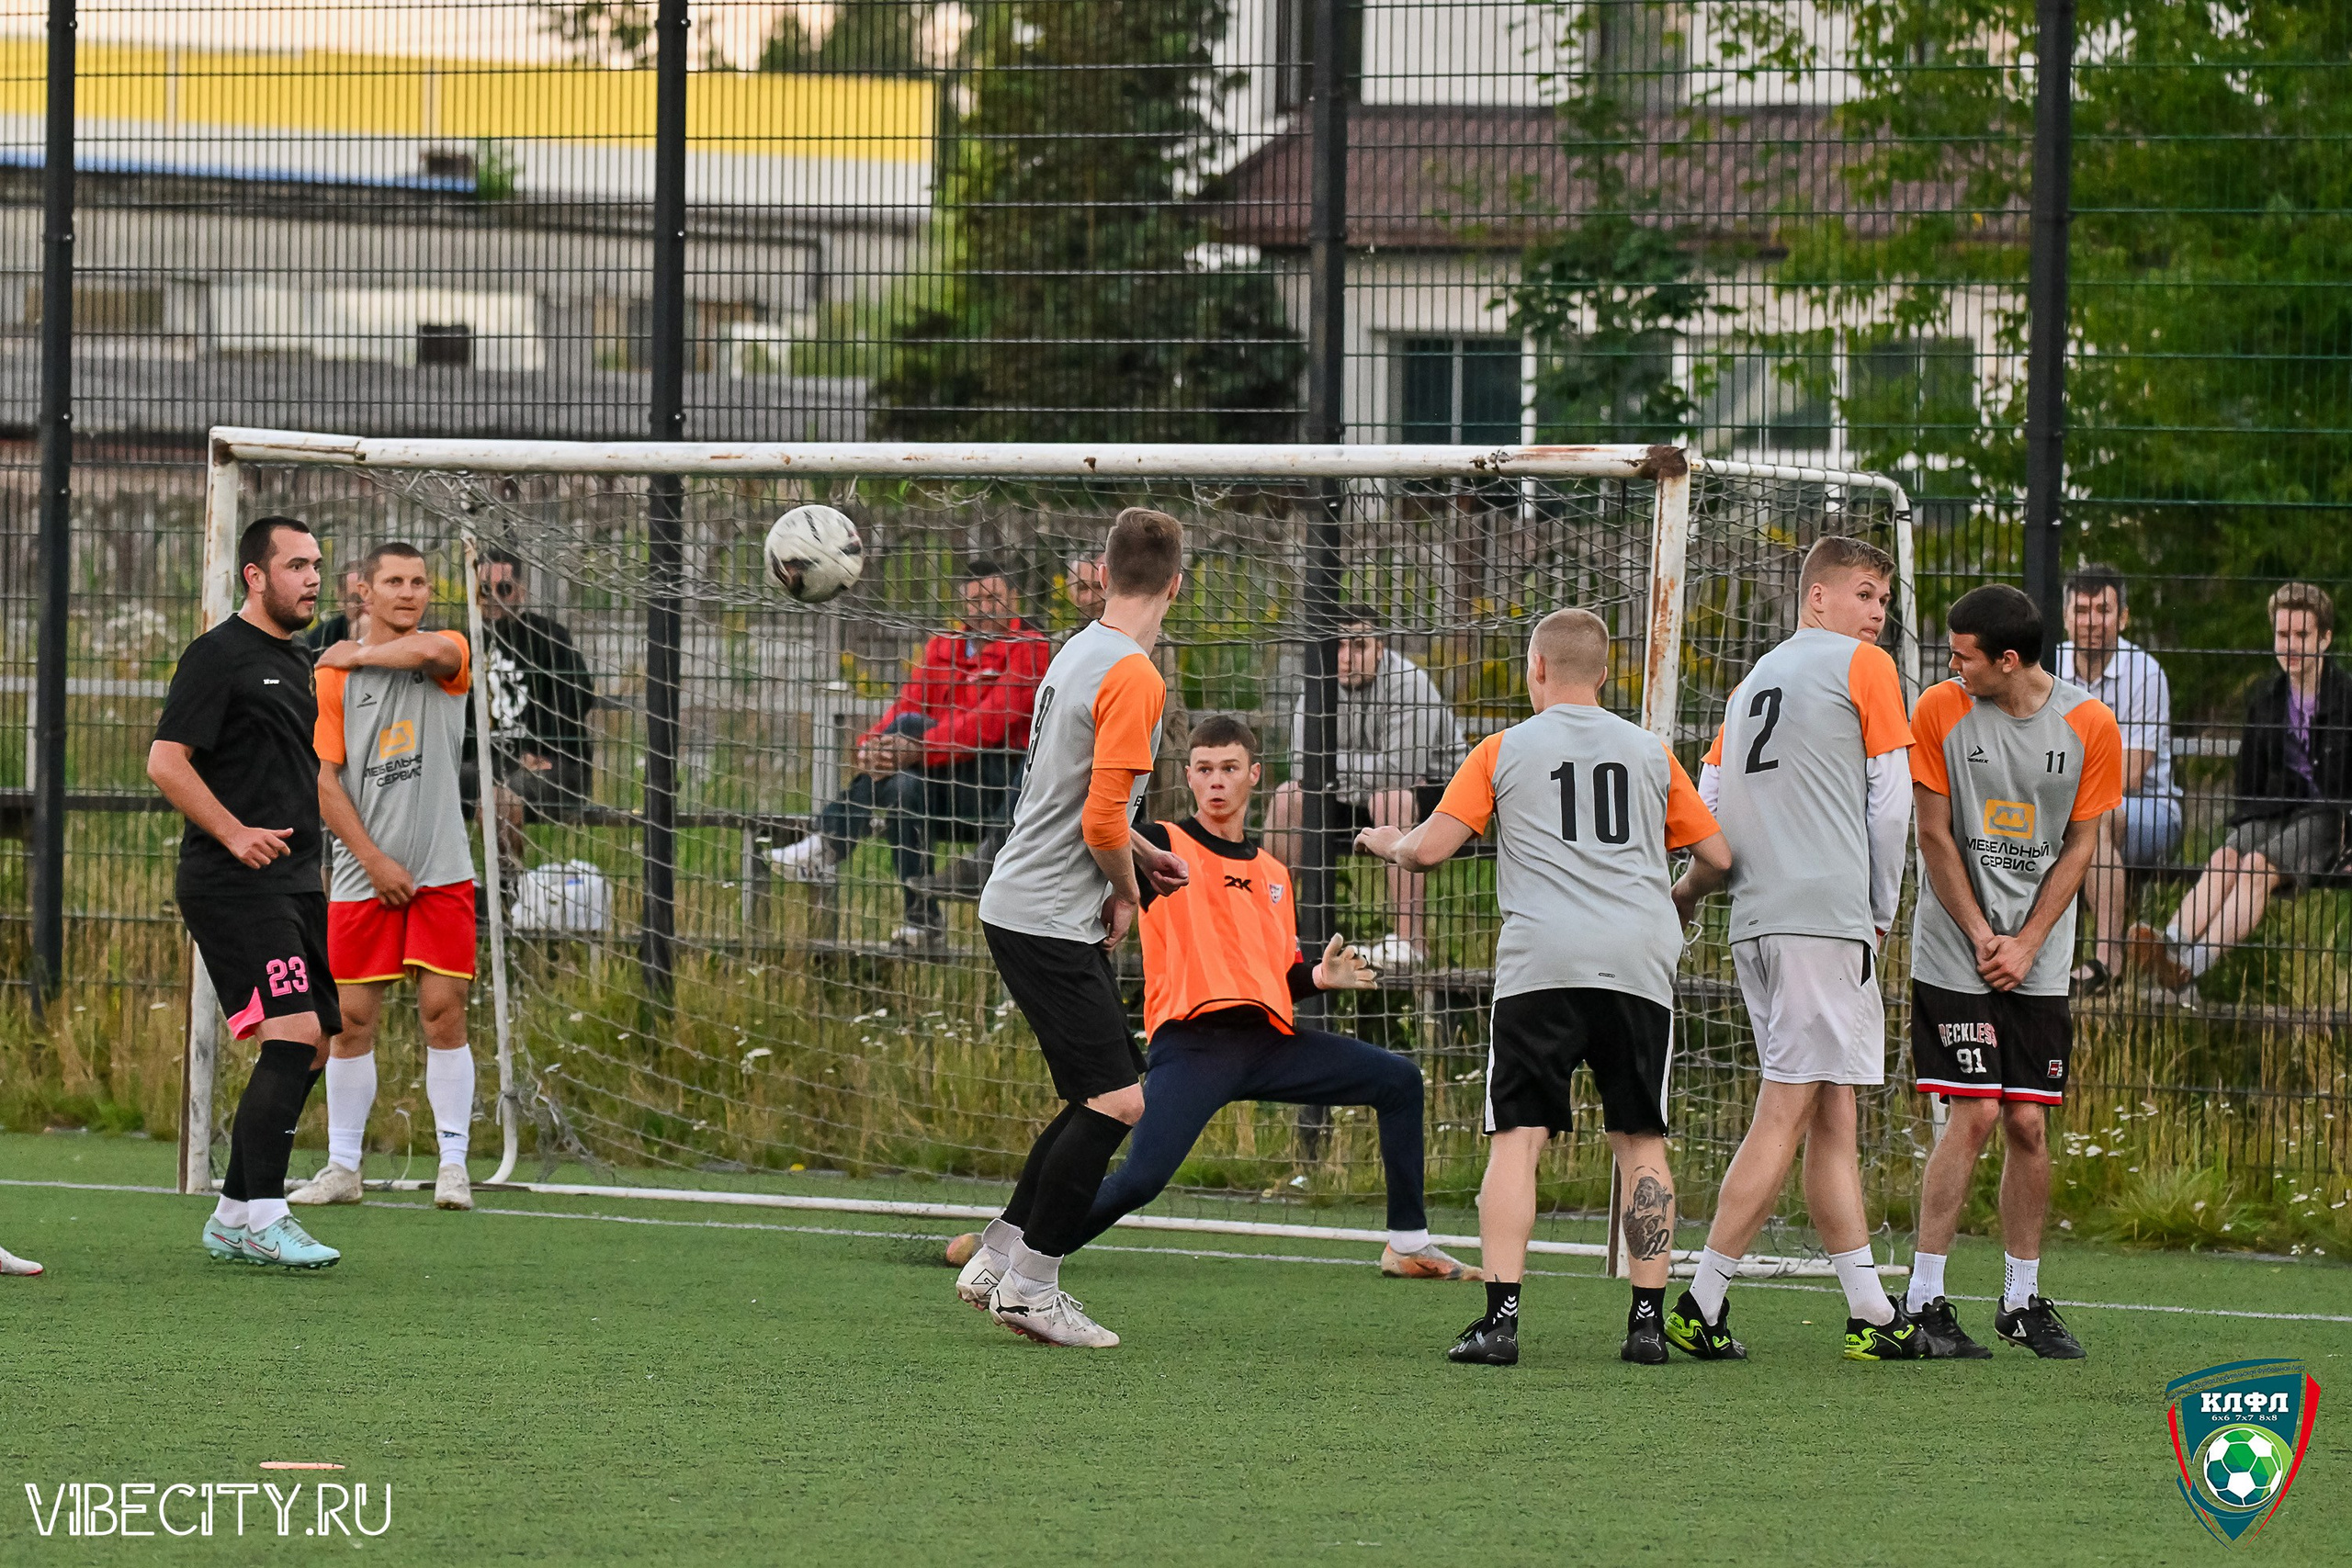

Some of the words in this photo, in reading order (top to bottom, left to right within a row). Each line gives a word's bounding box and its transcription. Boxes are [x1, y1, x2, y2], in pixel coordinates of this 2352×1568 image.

[1745, 687, 1782, 774] 2
[2045, 750, 2065, 774] 11
[1550, 761, 1630, 845] 10
[1980, 854, 2037, 872] СЕРВИС
[266, 955, 310, 998] 23
[1956, 1047, 1987, 1074] 91
